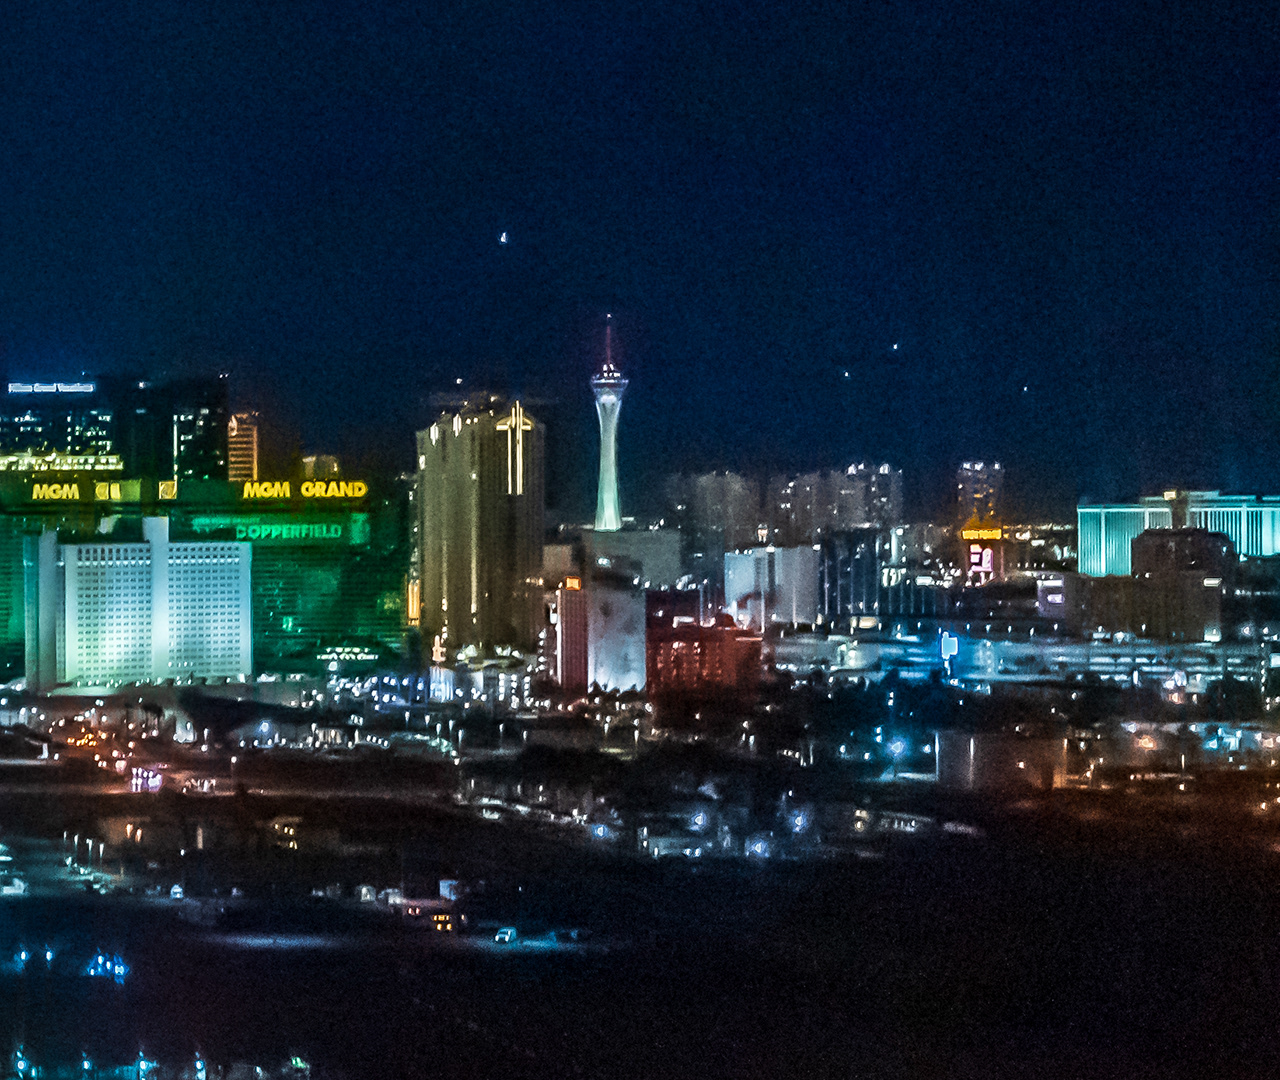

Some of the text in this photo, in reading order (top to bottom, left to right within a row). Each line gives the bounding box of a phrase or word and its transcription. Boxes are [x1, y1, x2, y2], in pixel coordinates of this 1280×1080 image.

[32, 483, 80, 500] MGM
[243, 481, 368, 498] MGM GRAND
